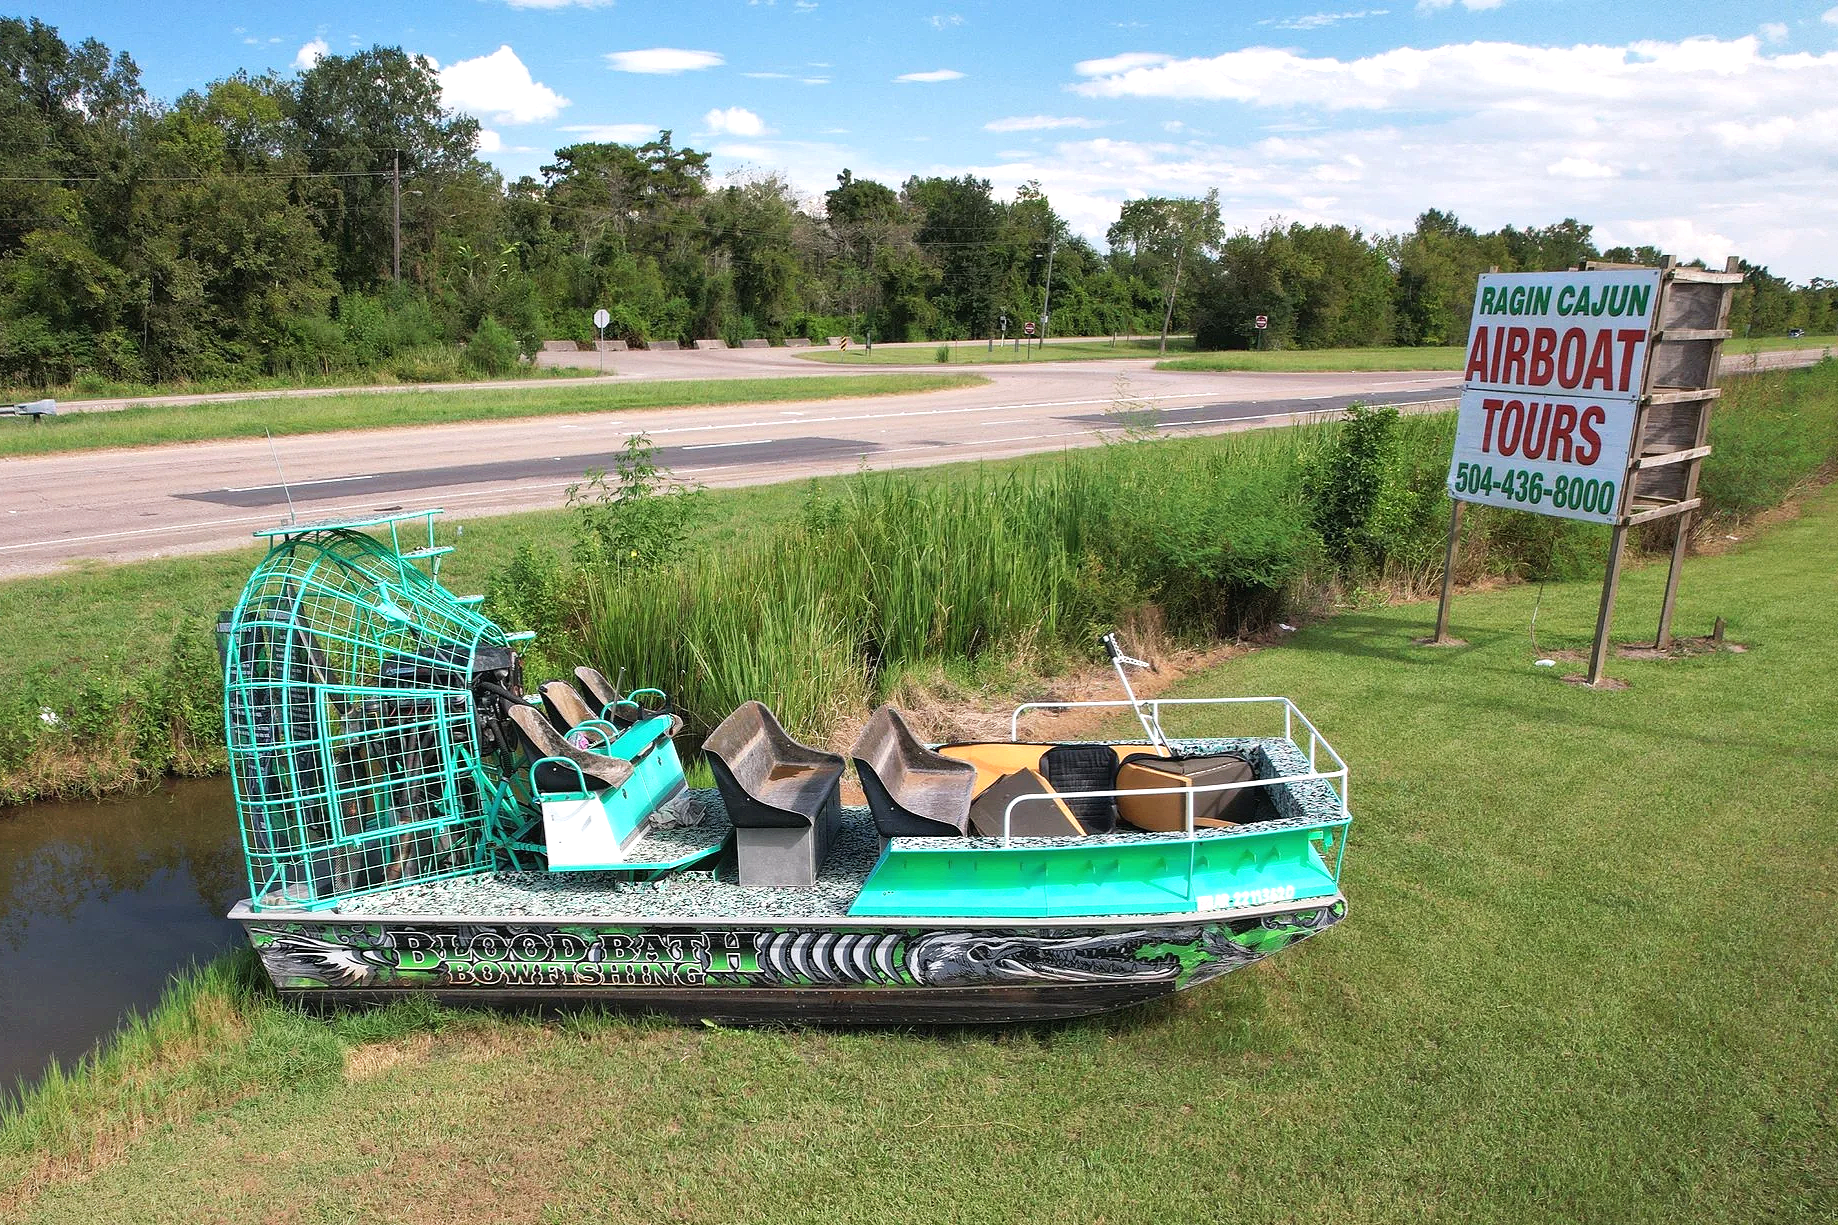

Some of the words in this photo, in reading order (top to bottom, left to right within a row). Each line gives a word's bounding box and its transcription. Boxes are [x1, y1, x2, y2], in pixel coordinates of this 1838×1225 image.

[1479, 285, 1552, 316] RAGIN
[1556, 284, 1651, 317] CAJUN
[1465, 325, 1647, 392] AIRBOAT
[1481, 398, 1606, 466] TOURS
[1454, 462, 1615, 515] 504-436-8000
[387, 931, 589, 970] BLOOD
[598, 931, 765, 973] BATH
[445, 961, 706, 986] BOWFISHING
